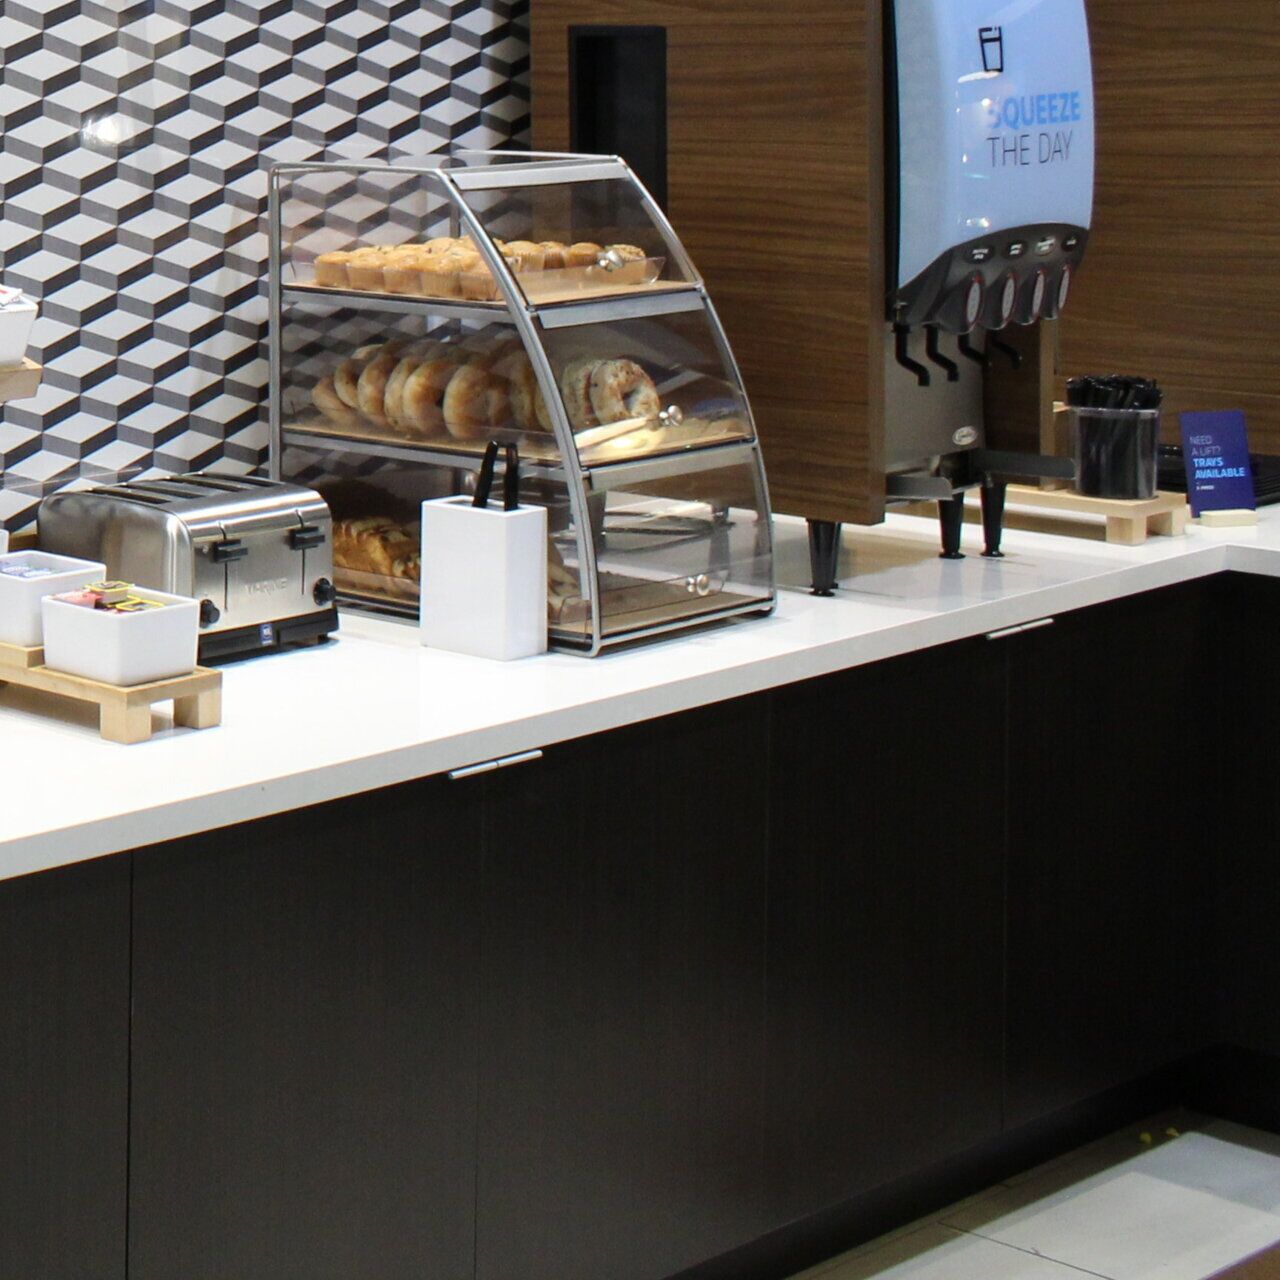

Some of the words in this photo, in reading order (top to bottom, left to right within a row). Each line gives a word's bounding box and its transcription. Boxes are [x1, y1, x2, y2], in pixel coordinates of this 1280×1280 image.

[986, 134, 1030, 168] THE
[1039, 128, 1073, 164] DAY
[1189, 435, 1213, 445] NEED
[1193, 457, 1224, 468] TRAYS
[1195, 467, 1246, 479] AVAILABLE
